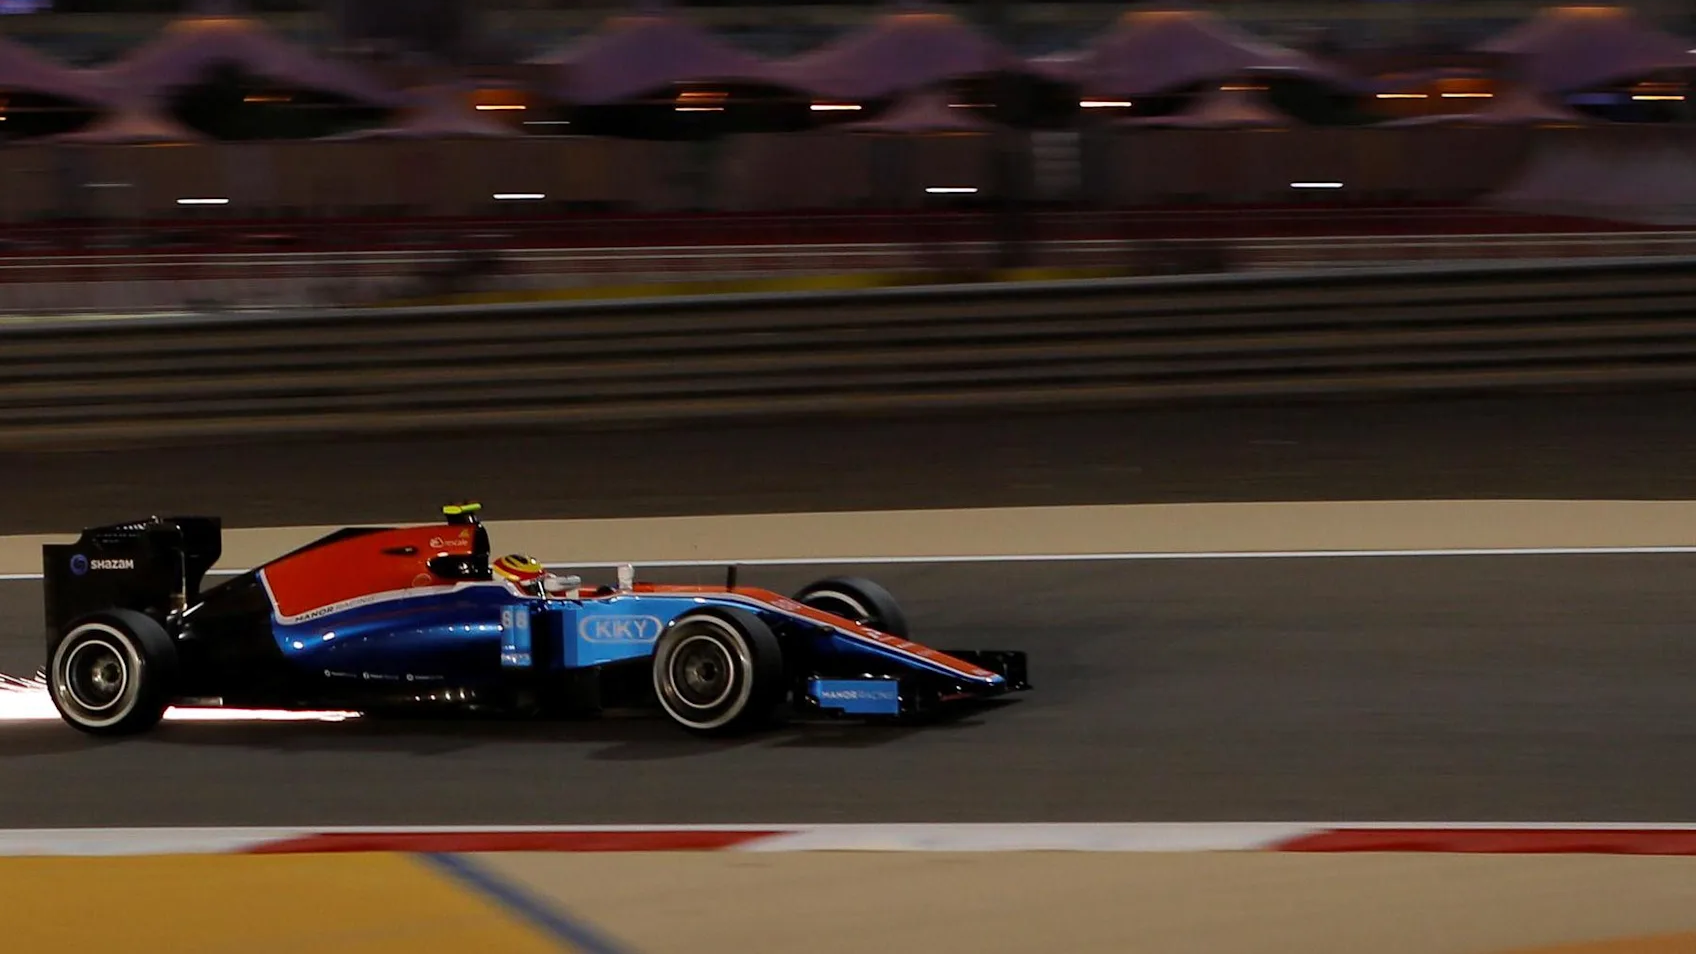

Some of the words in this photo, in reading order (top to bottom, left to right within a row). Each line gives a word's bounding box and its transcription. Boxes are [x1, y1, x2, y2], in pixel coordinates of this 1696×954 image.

[90, 558, 134, 570] SHAZAM
[295, 606, 334, 622] MANOR
[821, 689, 858, 700] MANOR
